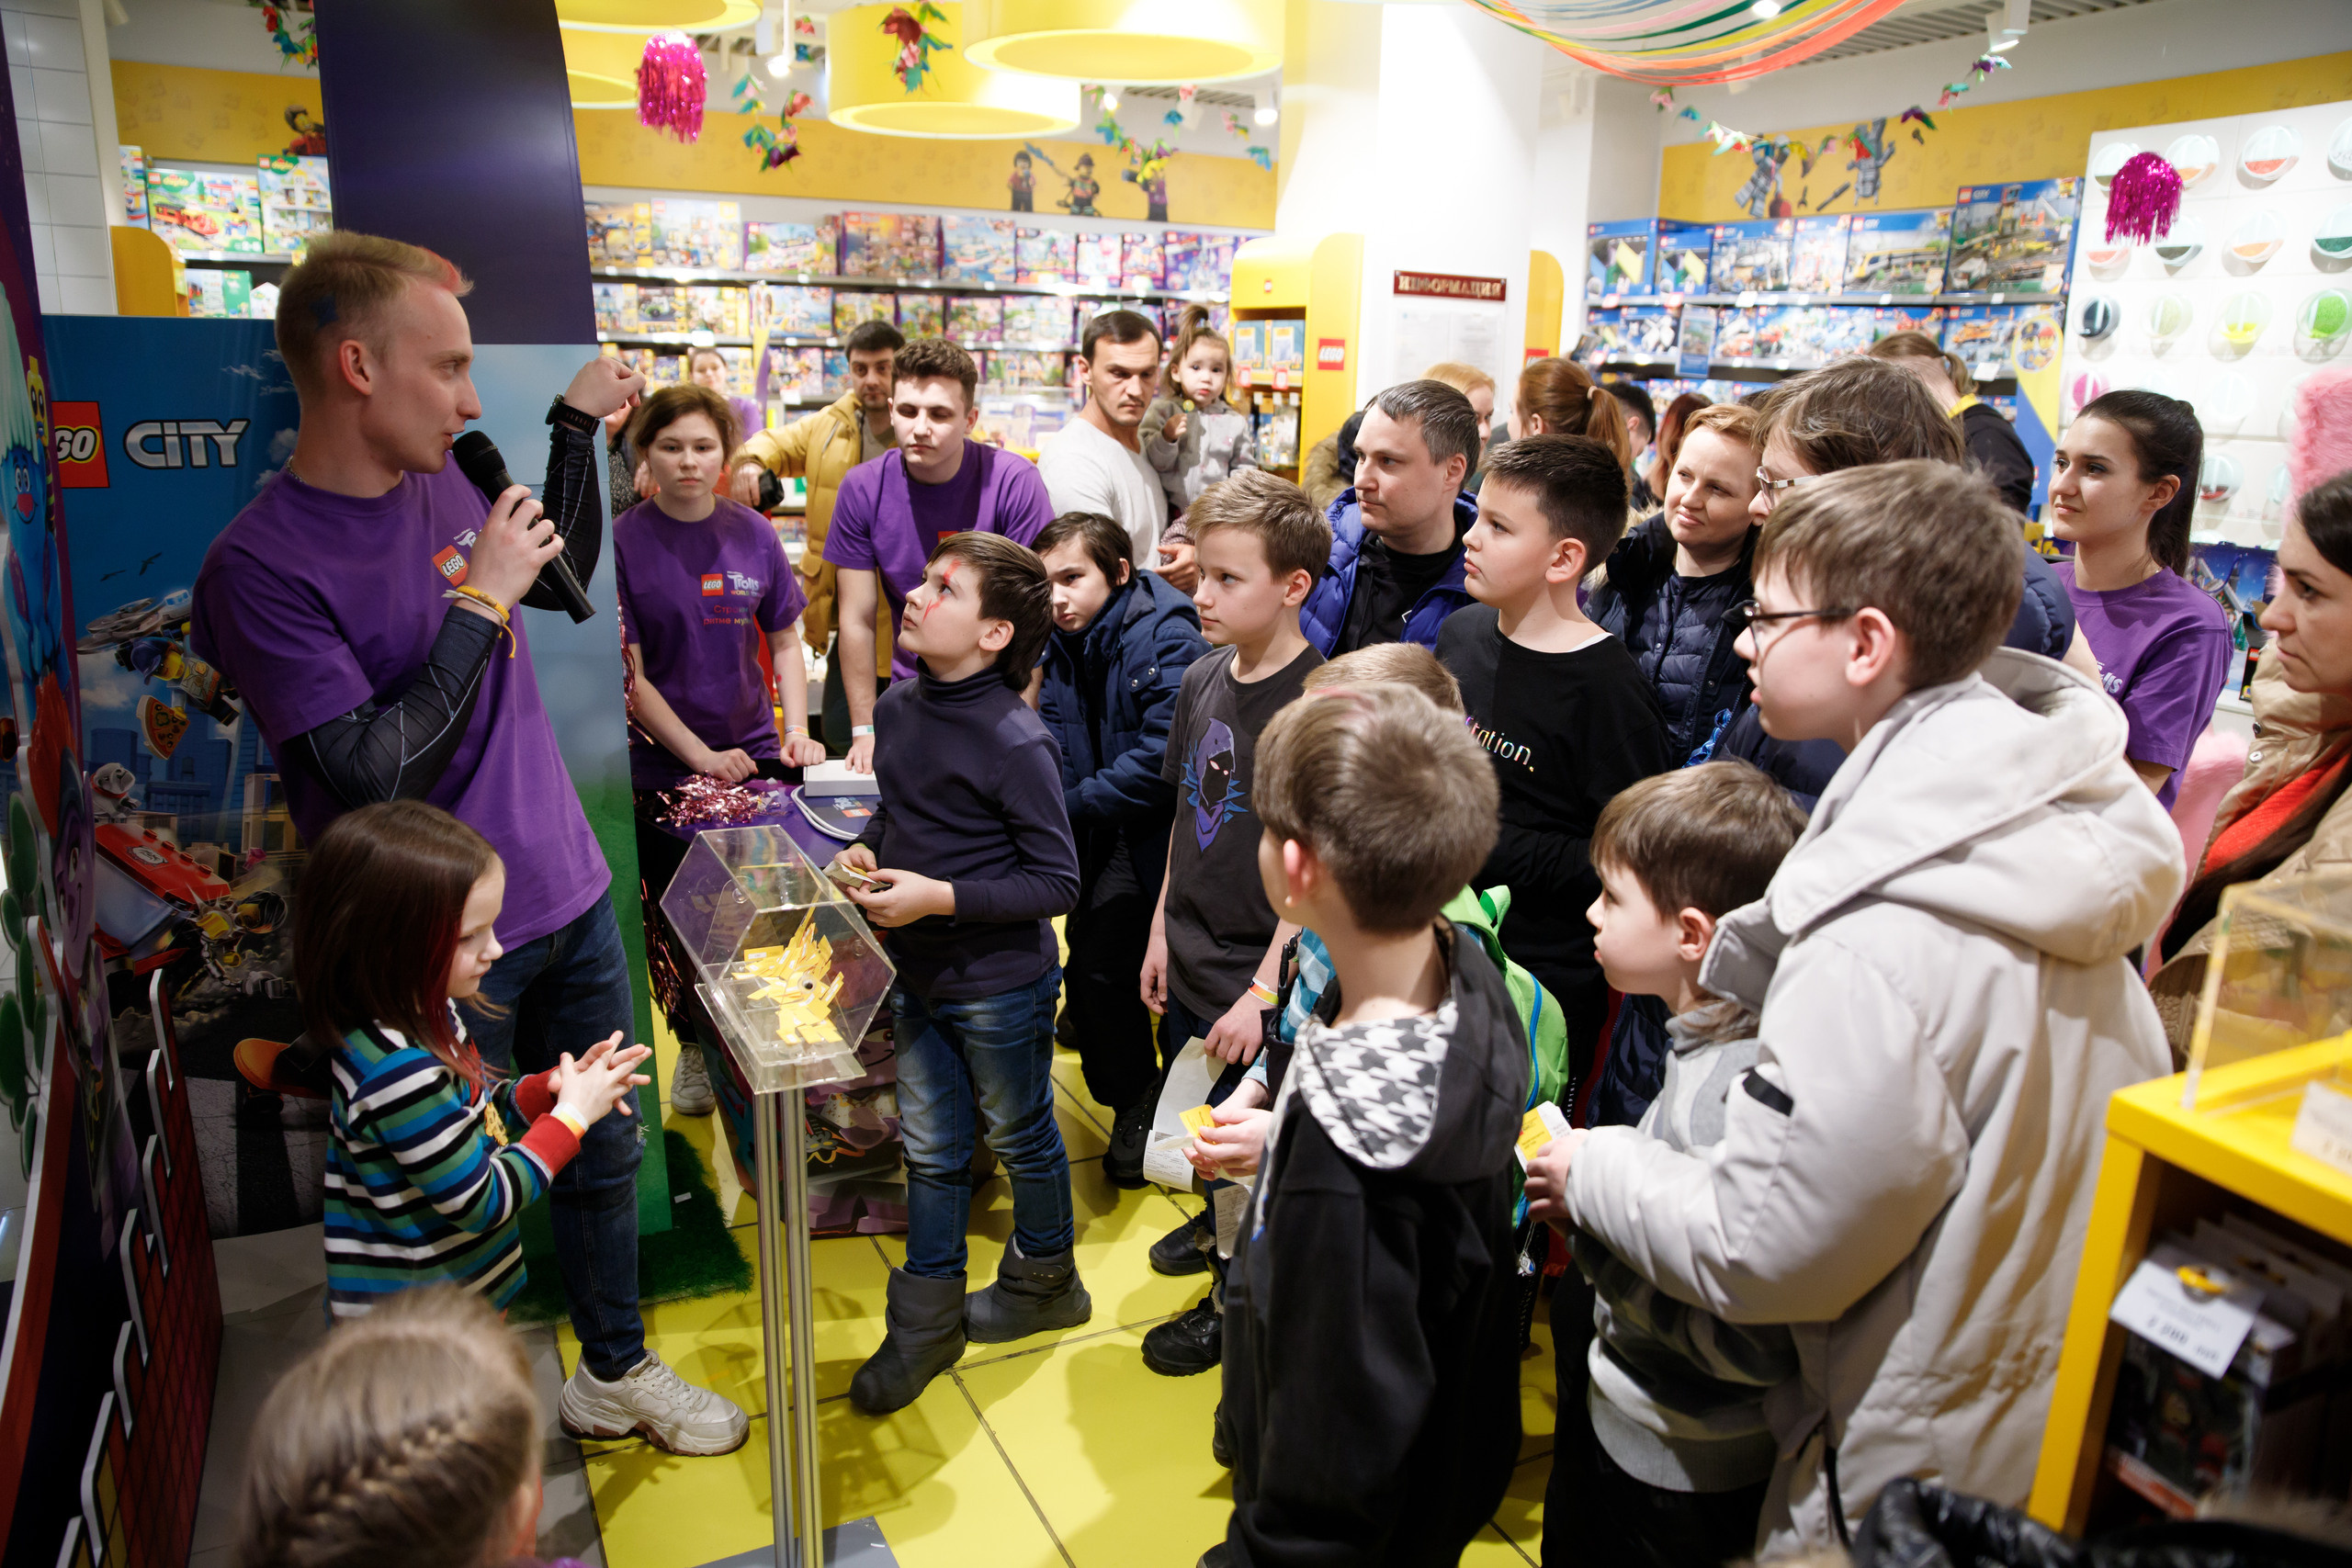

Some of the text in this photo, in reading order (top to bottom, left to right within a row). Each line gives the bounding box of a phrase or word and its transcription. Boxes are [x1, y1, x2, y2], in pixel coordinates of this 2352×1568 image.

[1397, 276, 1502, 299] ИНФОРМАЦИЯ
[1318, 346, 1345, 362] LEGO
[55, 419, 251, 469] GO CITY
[441, 554, 465, 577] LEGO
[703, 573, 760, 592] LEGO Trolls
